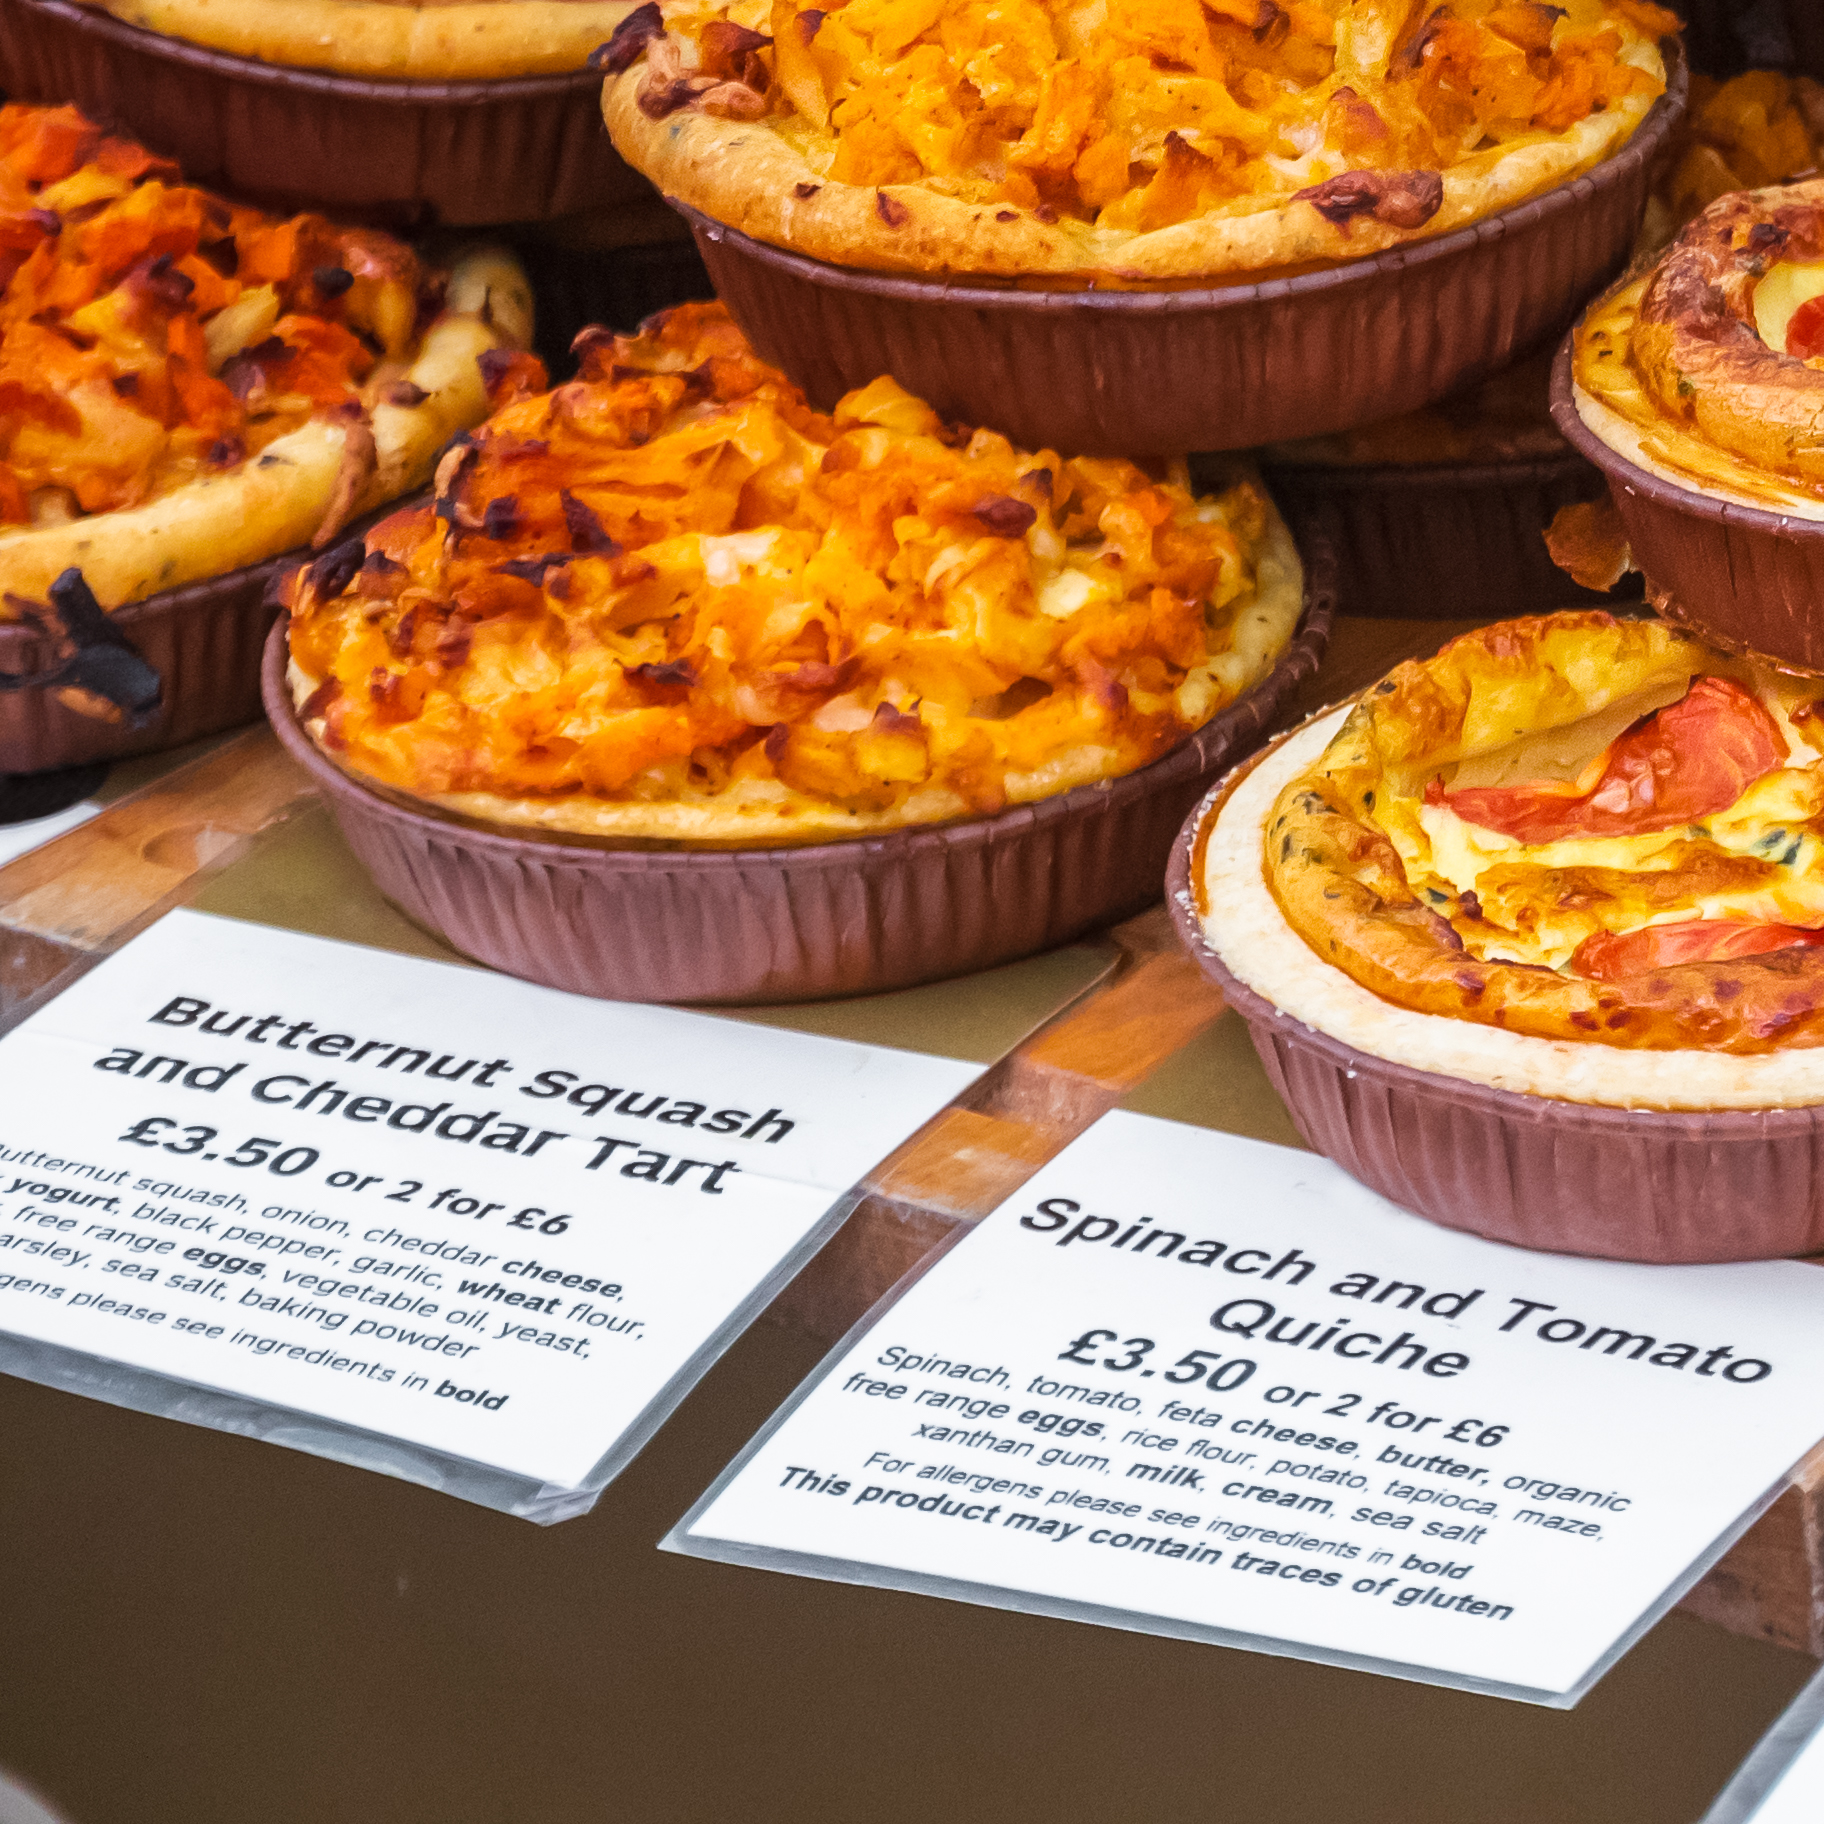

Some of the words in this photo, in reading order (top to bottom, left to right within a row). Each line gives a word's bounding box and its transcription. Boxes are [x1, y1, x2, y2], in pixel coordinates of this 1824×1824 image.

[93, 1047, 249, 1093] and
[251, 1075, 571, 1157] Cheddar
[585, 1136, 743, 1194] Tart
[146, 995, 514, 1088] Butternut
[519, 1070, 796, 1144] Squash
[0, 1144, 130, 1185] utternut
[132, 1178, 248, 1215] squash,
[261, 1206, 350, 1238] onion,
[363, 1228, 498, 1267] cheddar
[501, 1260, 623, 1303] cheese,
[118, 1117, 320, 1177] £3.50
[325, 1171, 384, 1192] or
[384, 1180, 423, 1203] 2
[427, 1188, 506, 1220] for
[506, 1207, 573, 1235] £6
[0, 1234, 92, 1268] arsley,
[101, 1259, 160, 1282] sea
[164, 1275, 227, 1302] salt,
[238, 1287, 349, 1330] baking
[349, 1319, 480, 1358] powder
[2, 1176, 121, 1216] yogurt,
[131, 1202, 219, 1234] black
[218, 1226, 342, 1266] pepper,
[348, 1257, 442, 1291] garlic,
[457, 1280, 562, 1315] wheat
[566, 1303, 645, 1341] flour,
[13, 1206, 78, 1231] free
[82, 1225, 177, 1254] range
[182, 1247, 267, 1281] eggs,
[283, 1270, 439, 1317] vegetable
[445, 1310, 489, 1333] oil,
[492, 1322, 590, 1360] yeast,
[1020, 1198, 1317, 1286] Spinach
[1329, 1273, 1487, 1320] and
[1498, 1297, 1773, 1383] Tomato
[67, 1292, 167, 1324] please
[171, 1318, 225, 1339] see
[230, 1328, 396, 1382] ingredients
[401, 1372, 429, 1391] in
[433, 1379, 509, 1411] bold
[1057, 1329, 1258, 1392] £3.50
[1263, 1386, 1322, 1407] or
[1322, 1393, 1362, 1417] 2
[1366, 1402, 1443, 1433] for
[1443, 1419, 1510, 1447] £6
[1209, 1299, 1470, 1378] Quiche
[842, 1372, 908, 1400] free
[913, 1390, 1010, 1419] range
[1017, 1410, 1107, 1442] eggs,
[1120, 1428, 1179, 1451] rice
[1185, 1439, 1258, 1470] flour,
[1265, 1459, 1368, 1493] potato,
[1384, 1480, 1498, 1519] tapioca,
[1513, 1509, 1603, 1541] maze,
[879, 1346, 1010, 1391] Spinach,
[1026, 1375, 1141, 1416] tomato,
[1158, 1400, 1223, 1428] feta
[1230, 1419, 1360, 1460] cheese,
[1376, 1445, 1489, 1486] butter,
[1503, 1476, 1632, 1512] organic
[911, 1424, 1035, 1457] xanthan
[1036, 1448, 1110, 1475] gum,
[1126, 1463, 1206, 1493] milk,
[1222, 1482, 1335, 1519] cream,
[1351, 1507, 1415, 1530] sea
[1421, 1522, 1487, 1545] salt
[779, 1466, 851, 1496] This
[852, 1486, 1002, 1524] product
[1003, 1513, 1084, 1542] may
[1088, 1529, 1223, 1565] contain
[1231, 1551, 1343, 1587] traces
[1351, 1578, 1400, 1596] of
[1392, 1586, 1514, 1620] gluten
[863, 1451, 916, 1473] For
[916, 1465, 1044, 1499] allergens
[1045, 1489, 1142, 1517] please
[1147, 1509, 1201, 1528] see
[1206, 1518, 1362, 1559] ingredients
[1367, 1549, 1394, 1565] in
[1399, 1554, 1475, 1580] bold
